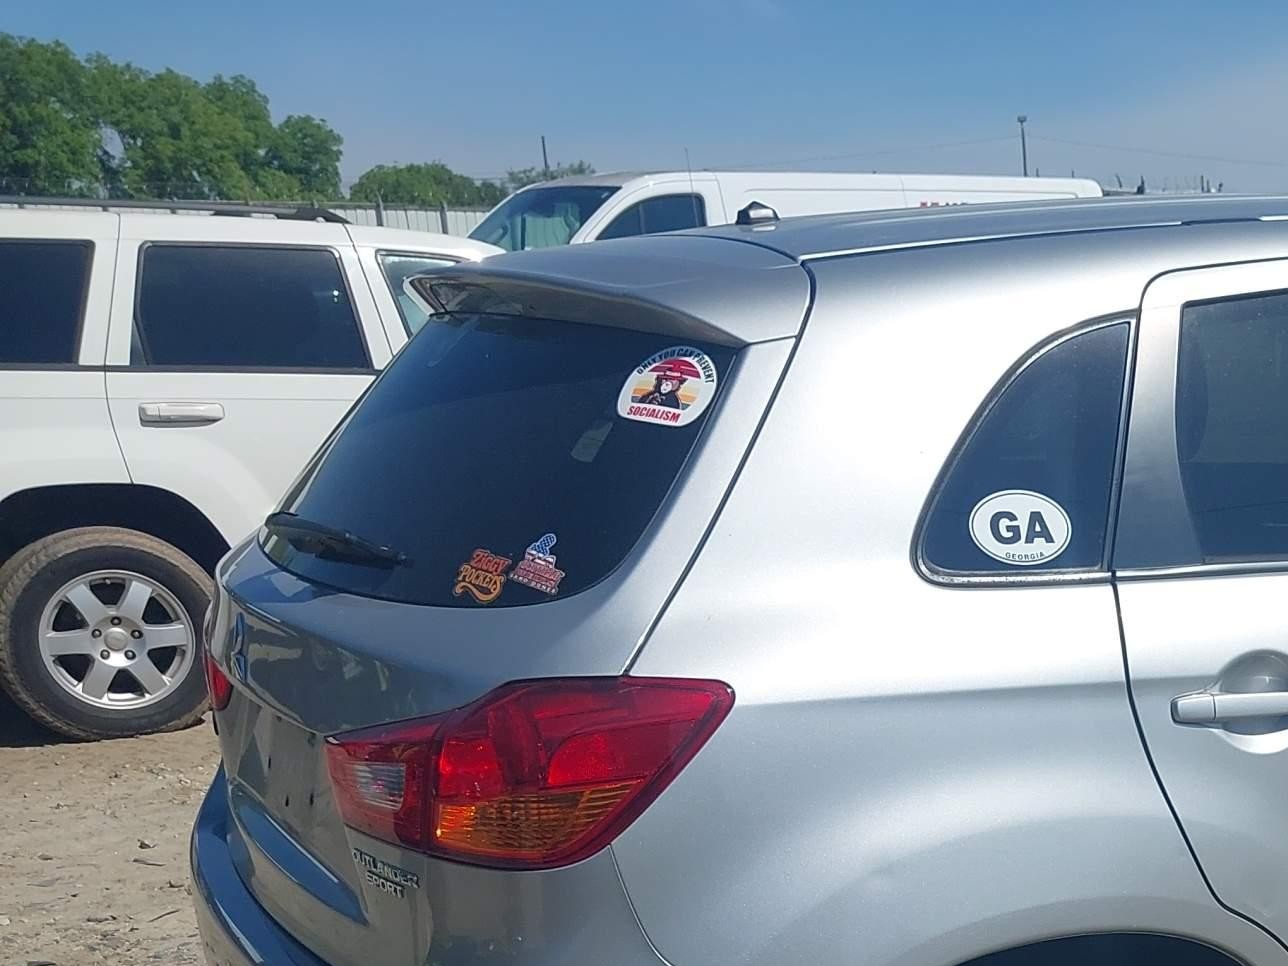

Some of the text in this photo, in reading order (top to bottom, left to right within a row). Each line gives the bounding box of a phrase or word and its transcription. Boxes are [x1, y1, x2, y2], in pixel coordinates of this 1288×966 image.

[692, 350, 714, 383] PREVENT
[627, 405, 681, 423] SOCIALISM
[990, 510, 1056, 545] GA
[472, 551, 510, 575] ZIGGY
[1005, 552, 1045, 560] GEORGIA
[457, 564, 504, 596] POCKETS
[352, 848, 420, 889] OUTLANDER
